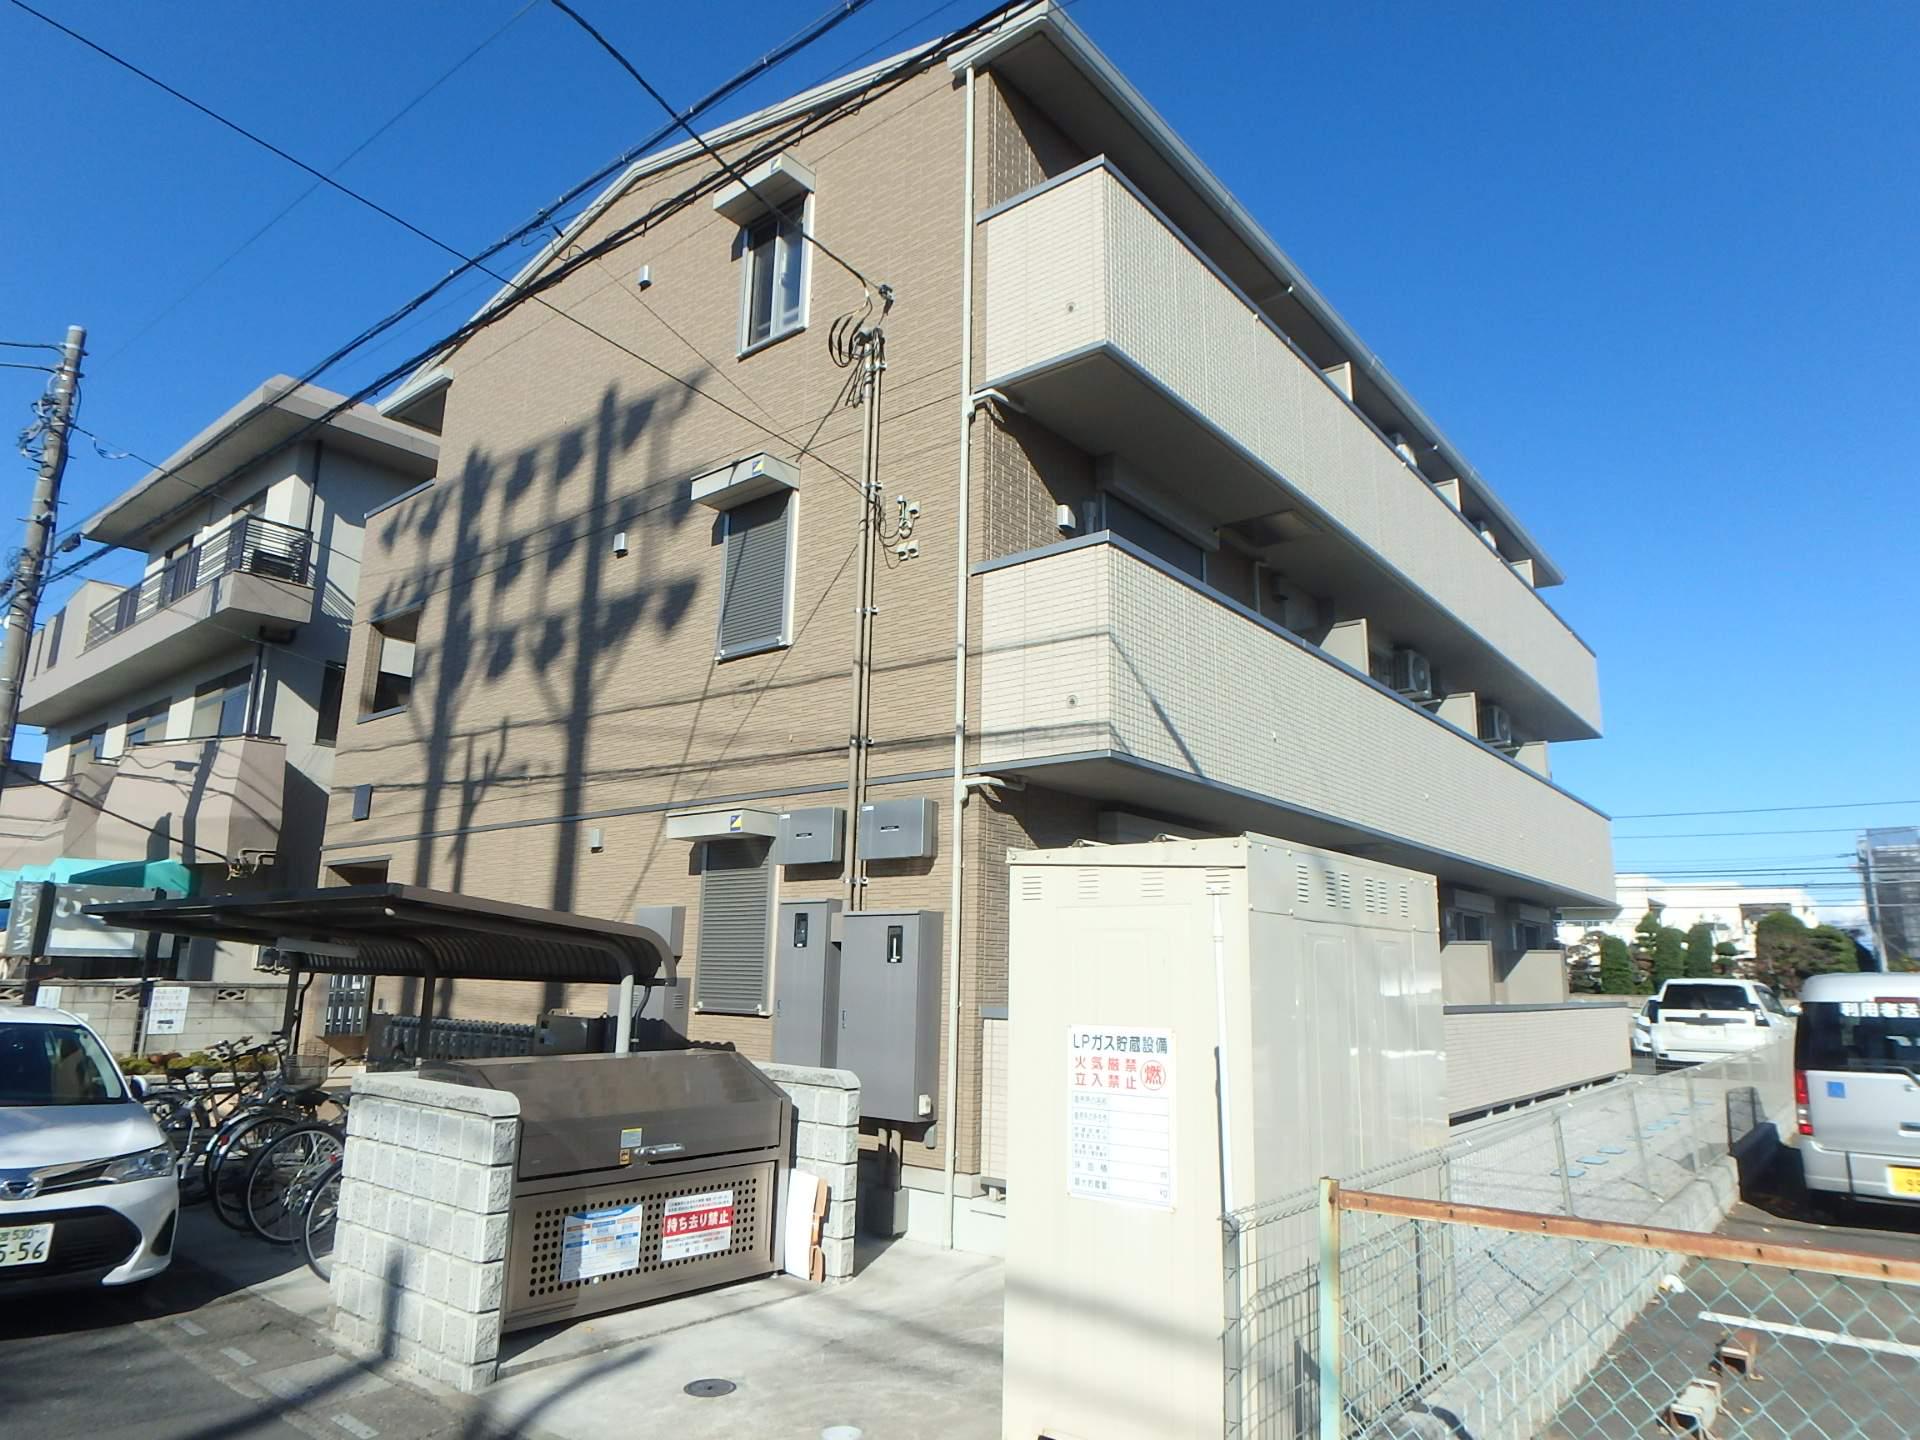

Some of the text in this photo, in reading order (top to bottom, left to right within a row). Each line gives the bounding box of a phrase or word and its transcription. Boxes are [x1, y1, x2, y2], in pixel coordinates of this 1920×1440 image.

[1073, 1033, 1168, 1055] LPガス貯蔵設備
[1074, 1056, 1137, 1072] 火気厳禁
[1074, 1072, 1137, 1090] 立入禁止
[666, 1210, 729, 1234] 持ち去り禁止
